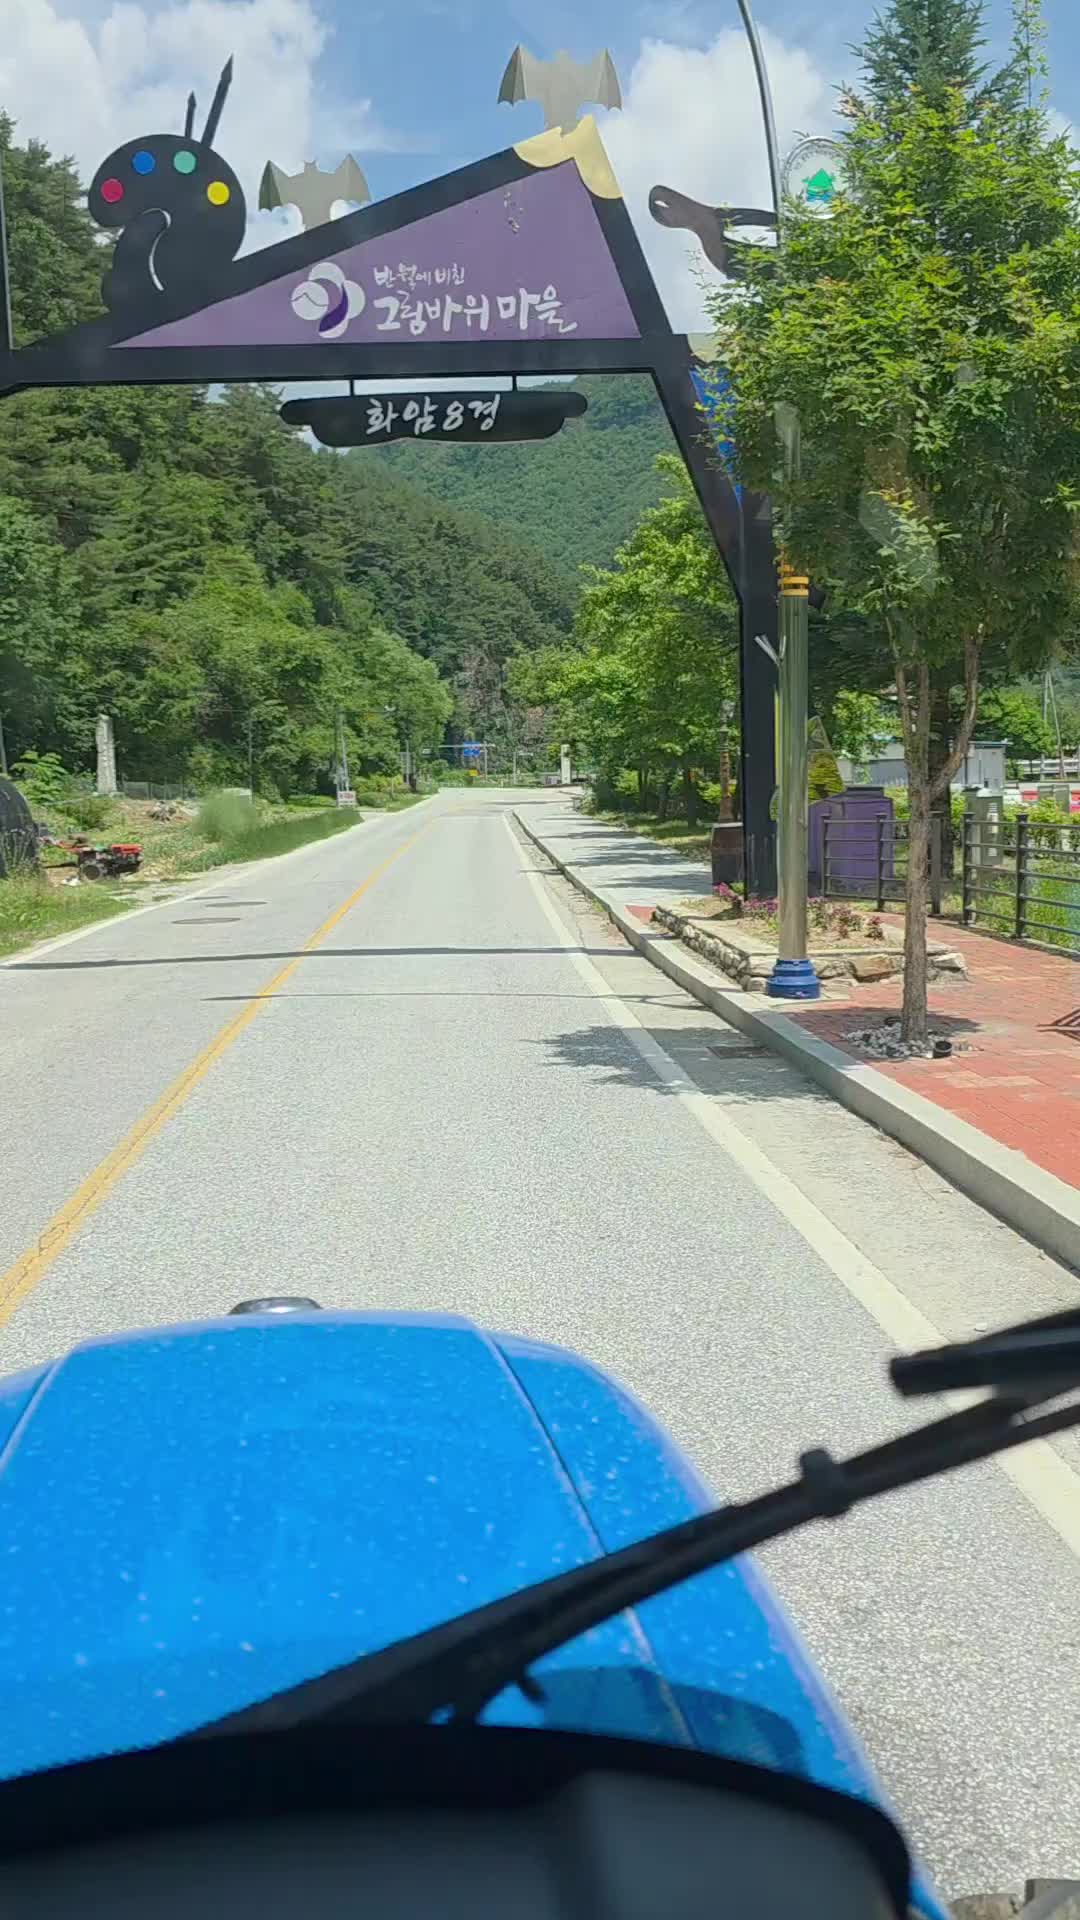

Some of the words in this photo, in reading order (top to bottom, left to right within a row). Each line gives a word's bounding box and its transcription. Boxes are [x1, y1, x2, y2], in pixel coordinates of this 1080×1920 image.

[374, 263, 431, 290] 반월에
[435, 263, 464, 286] 비친
[374, 290, 489, 335] 그림바위
[497, 284, 577, 333] 마을
